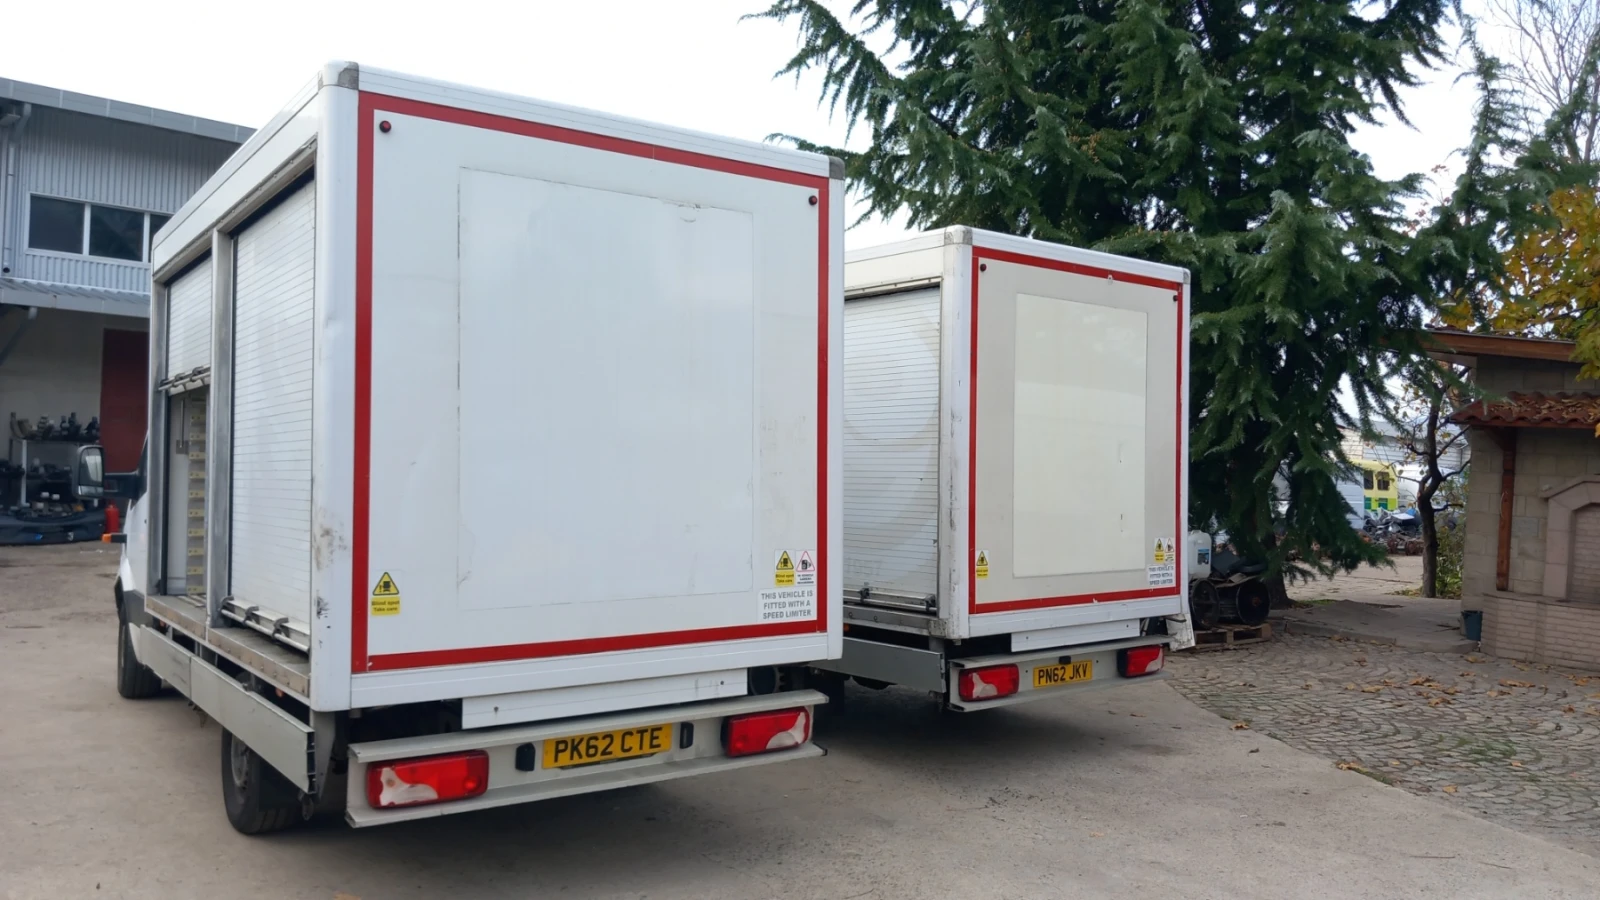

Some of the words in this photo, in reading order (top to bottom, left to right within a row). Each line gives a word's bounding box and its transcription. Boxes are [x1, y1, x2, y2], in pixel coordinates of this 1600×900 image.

[761, 592, 776, 600] THIS
[778, 590, 805, 599] VEHICLE
[807, 589, 813, 597] IS
[788, 600, 804, 608] WITH
[763, 611, 784, 620] SPEED
[1038, 666, 1066, 684] PN62
[1069, 663, 1088, 679] JKV
[554, 734, 614, 763] PK62
[620, 727, 662, 753] CTE
